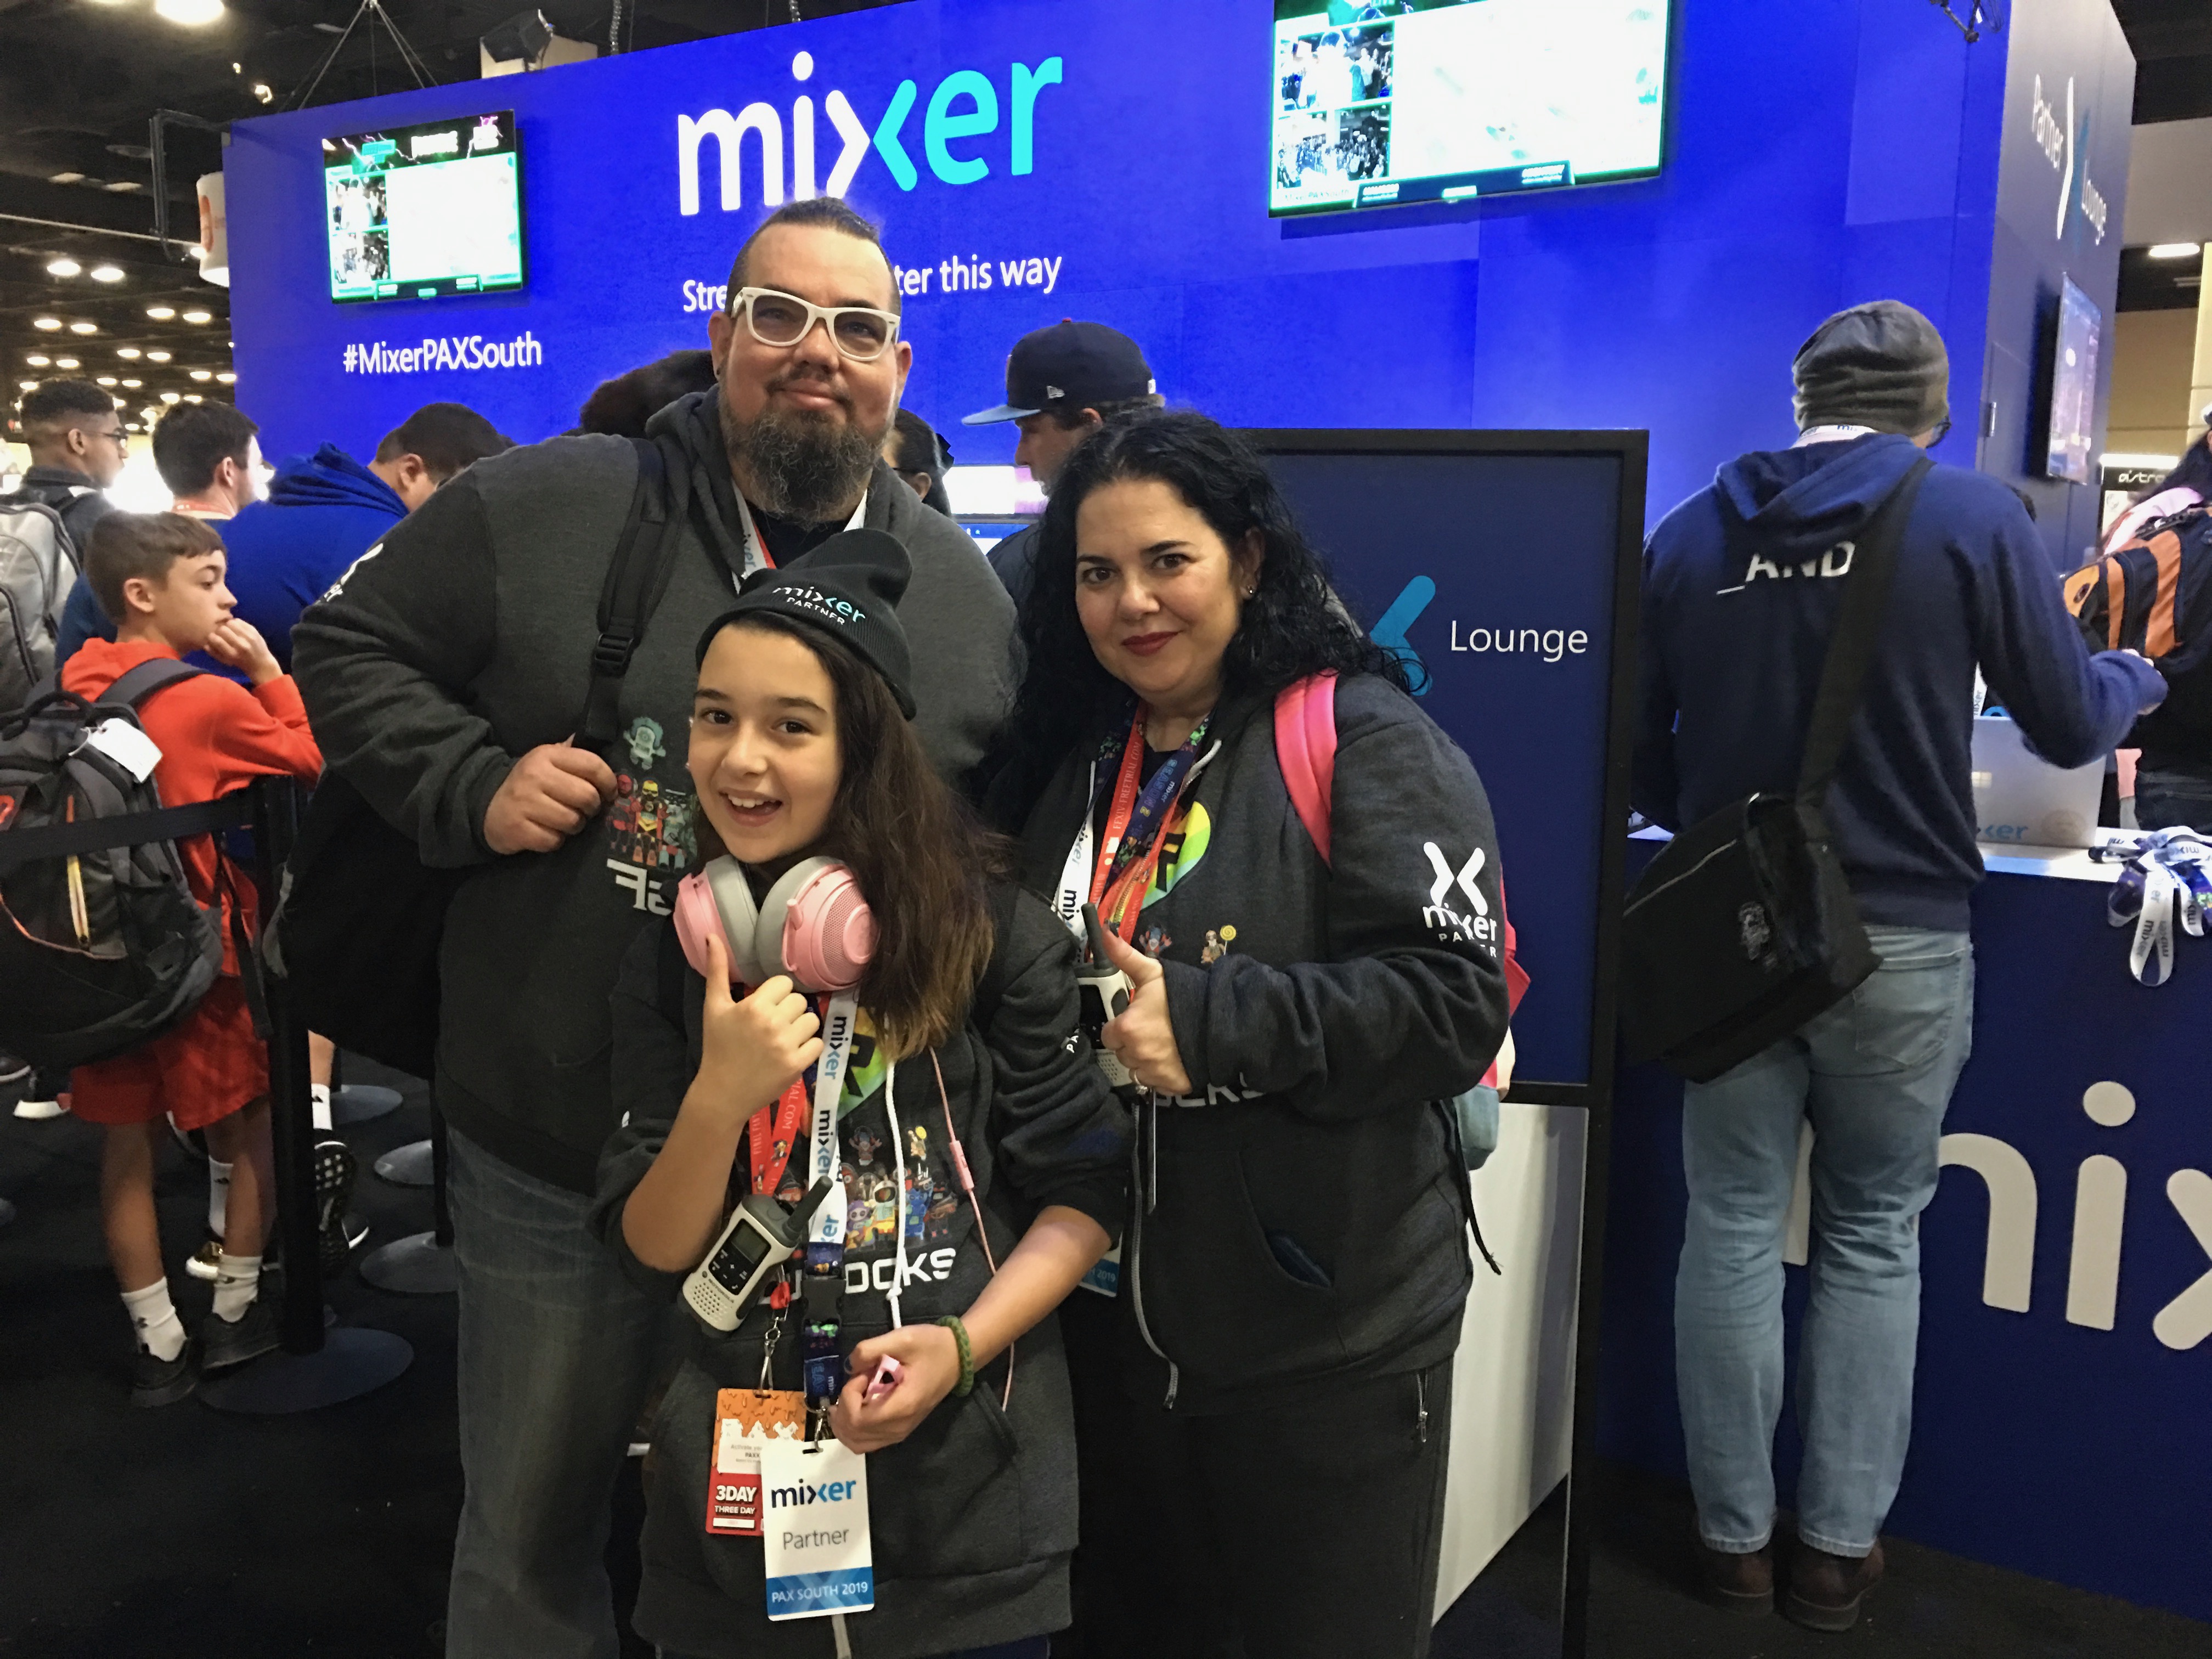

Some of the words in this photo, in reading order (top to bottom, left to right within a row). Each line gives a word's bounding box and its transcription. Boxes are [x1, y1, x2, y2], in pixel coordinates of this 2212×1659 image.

[678, 51, 1063, 216] mixer
[2032, 74, 2064, 172] Partner
[2081, 159, 2107, 246] Lounge
[682, 280, 727, 312] Stre
[939, 253, 992, 293] this
[1000, 255, 1063, 294] way
[343, 331, 542, 375] #MixerPAXSouth
[772, 586, 866, 623] mixer
[1451, 620, 1588, 663] Lounge
[1160, 781, 1175, 803] mixer
[825, 1016, 849, 1080] mixer
[715, 1485, 757, 1502] 3DAY
[715, 1505, 738, 1514] THREE
[740, 1506, 755, 1515] DAY
[771, 1479, 856, 1508] mixer
[783, 1528, 849, 1550] Partner
[772, 1590, 794, 1603] PAX
[797, 1585, 838, 1600] SOUTH
[842, 1581, 868, 1595] 2019
